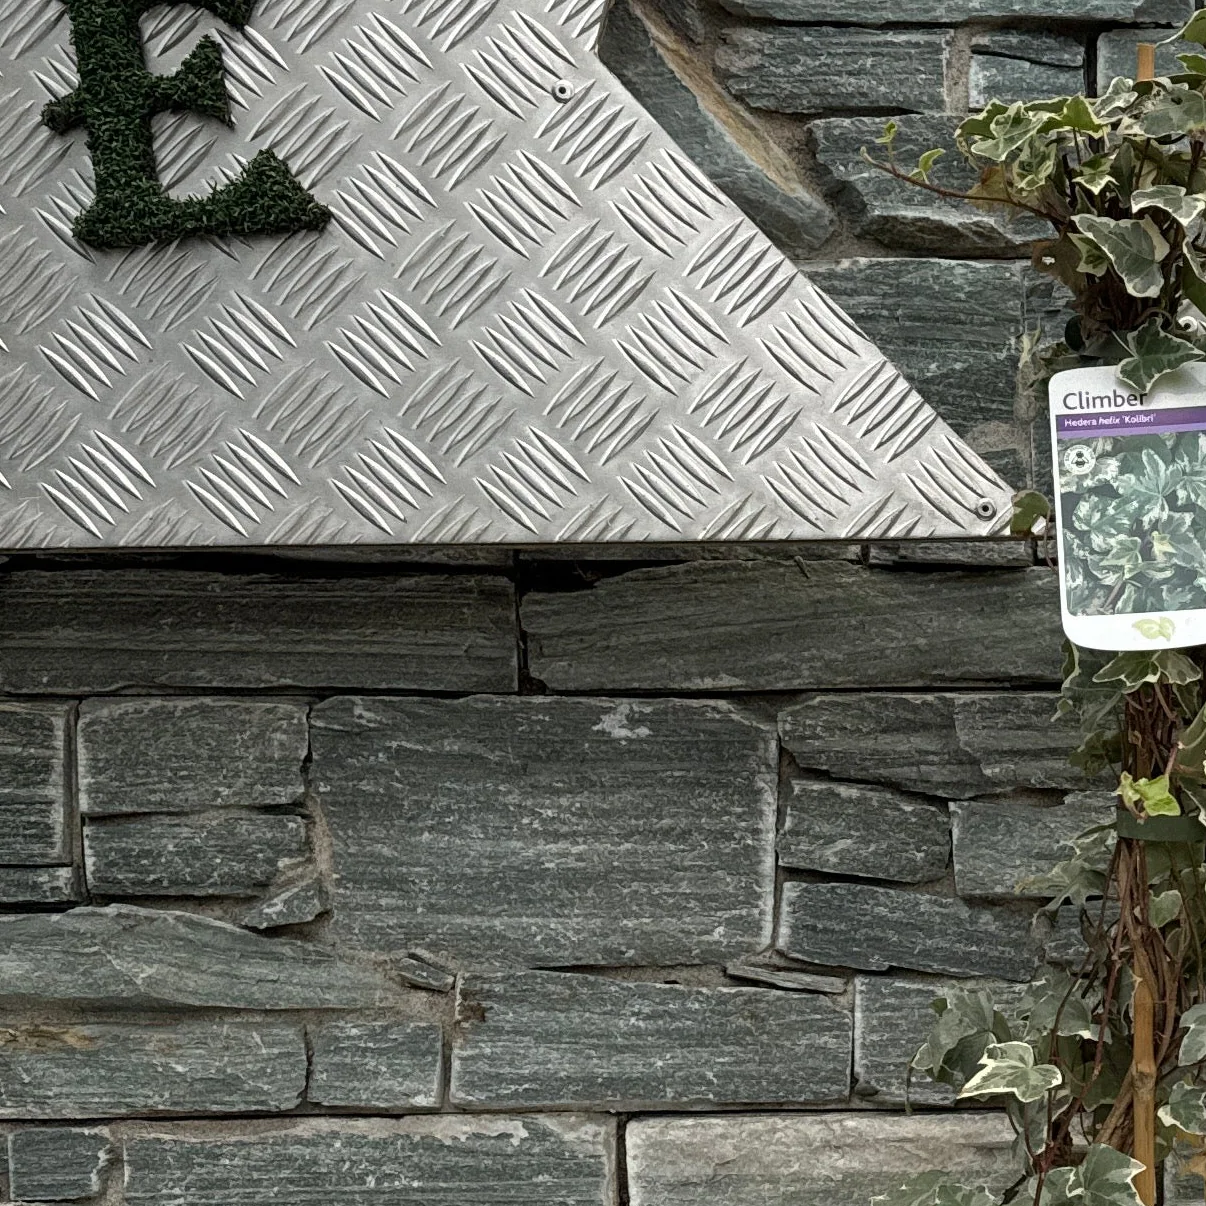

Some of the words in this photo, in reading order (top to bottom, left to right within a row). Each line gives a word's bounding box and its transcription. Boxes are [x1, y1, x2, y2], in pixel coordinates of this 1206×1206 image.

[1062, 389, 1148, 411] Climber
[1064, 417, 1098, 428] Hedera
[1098, 415, 1120, 426] helix
